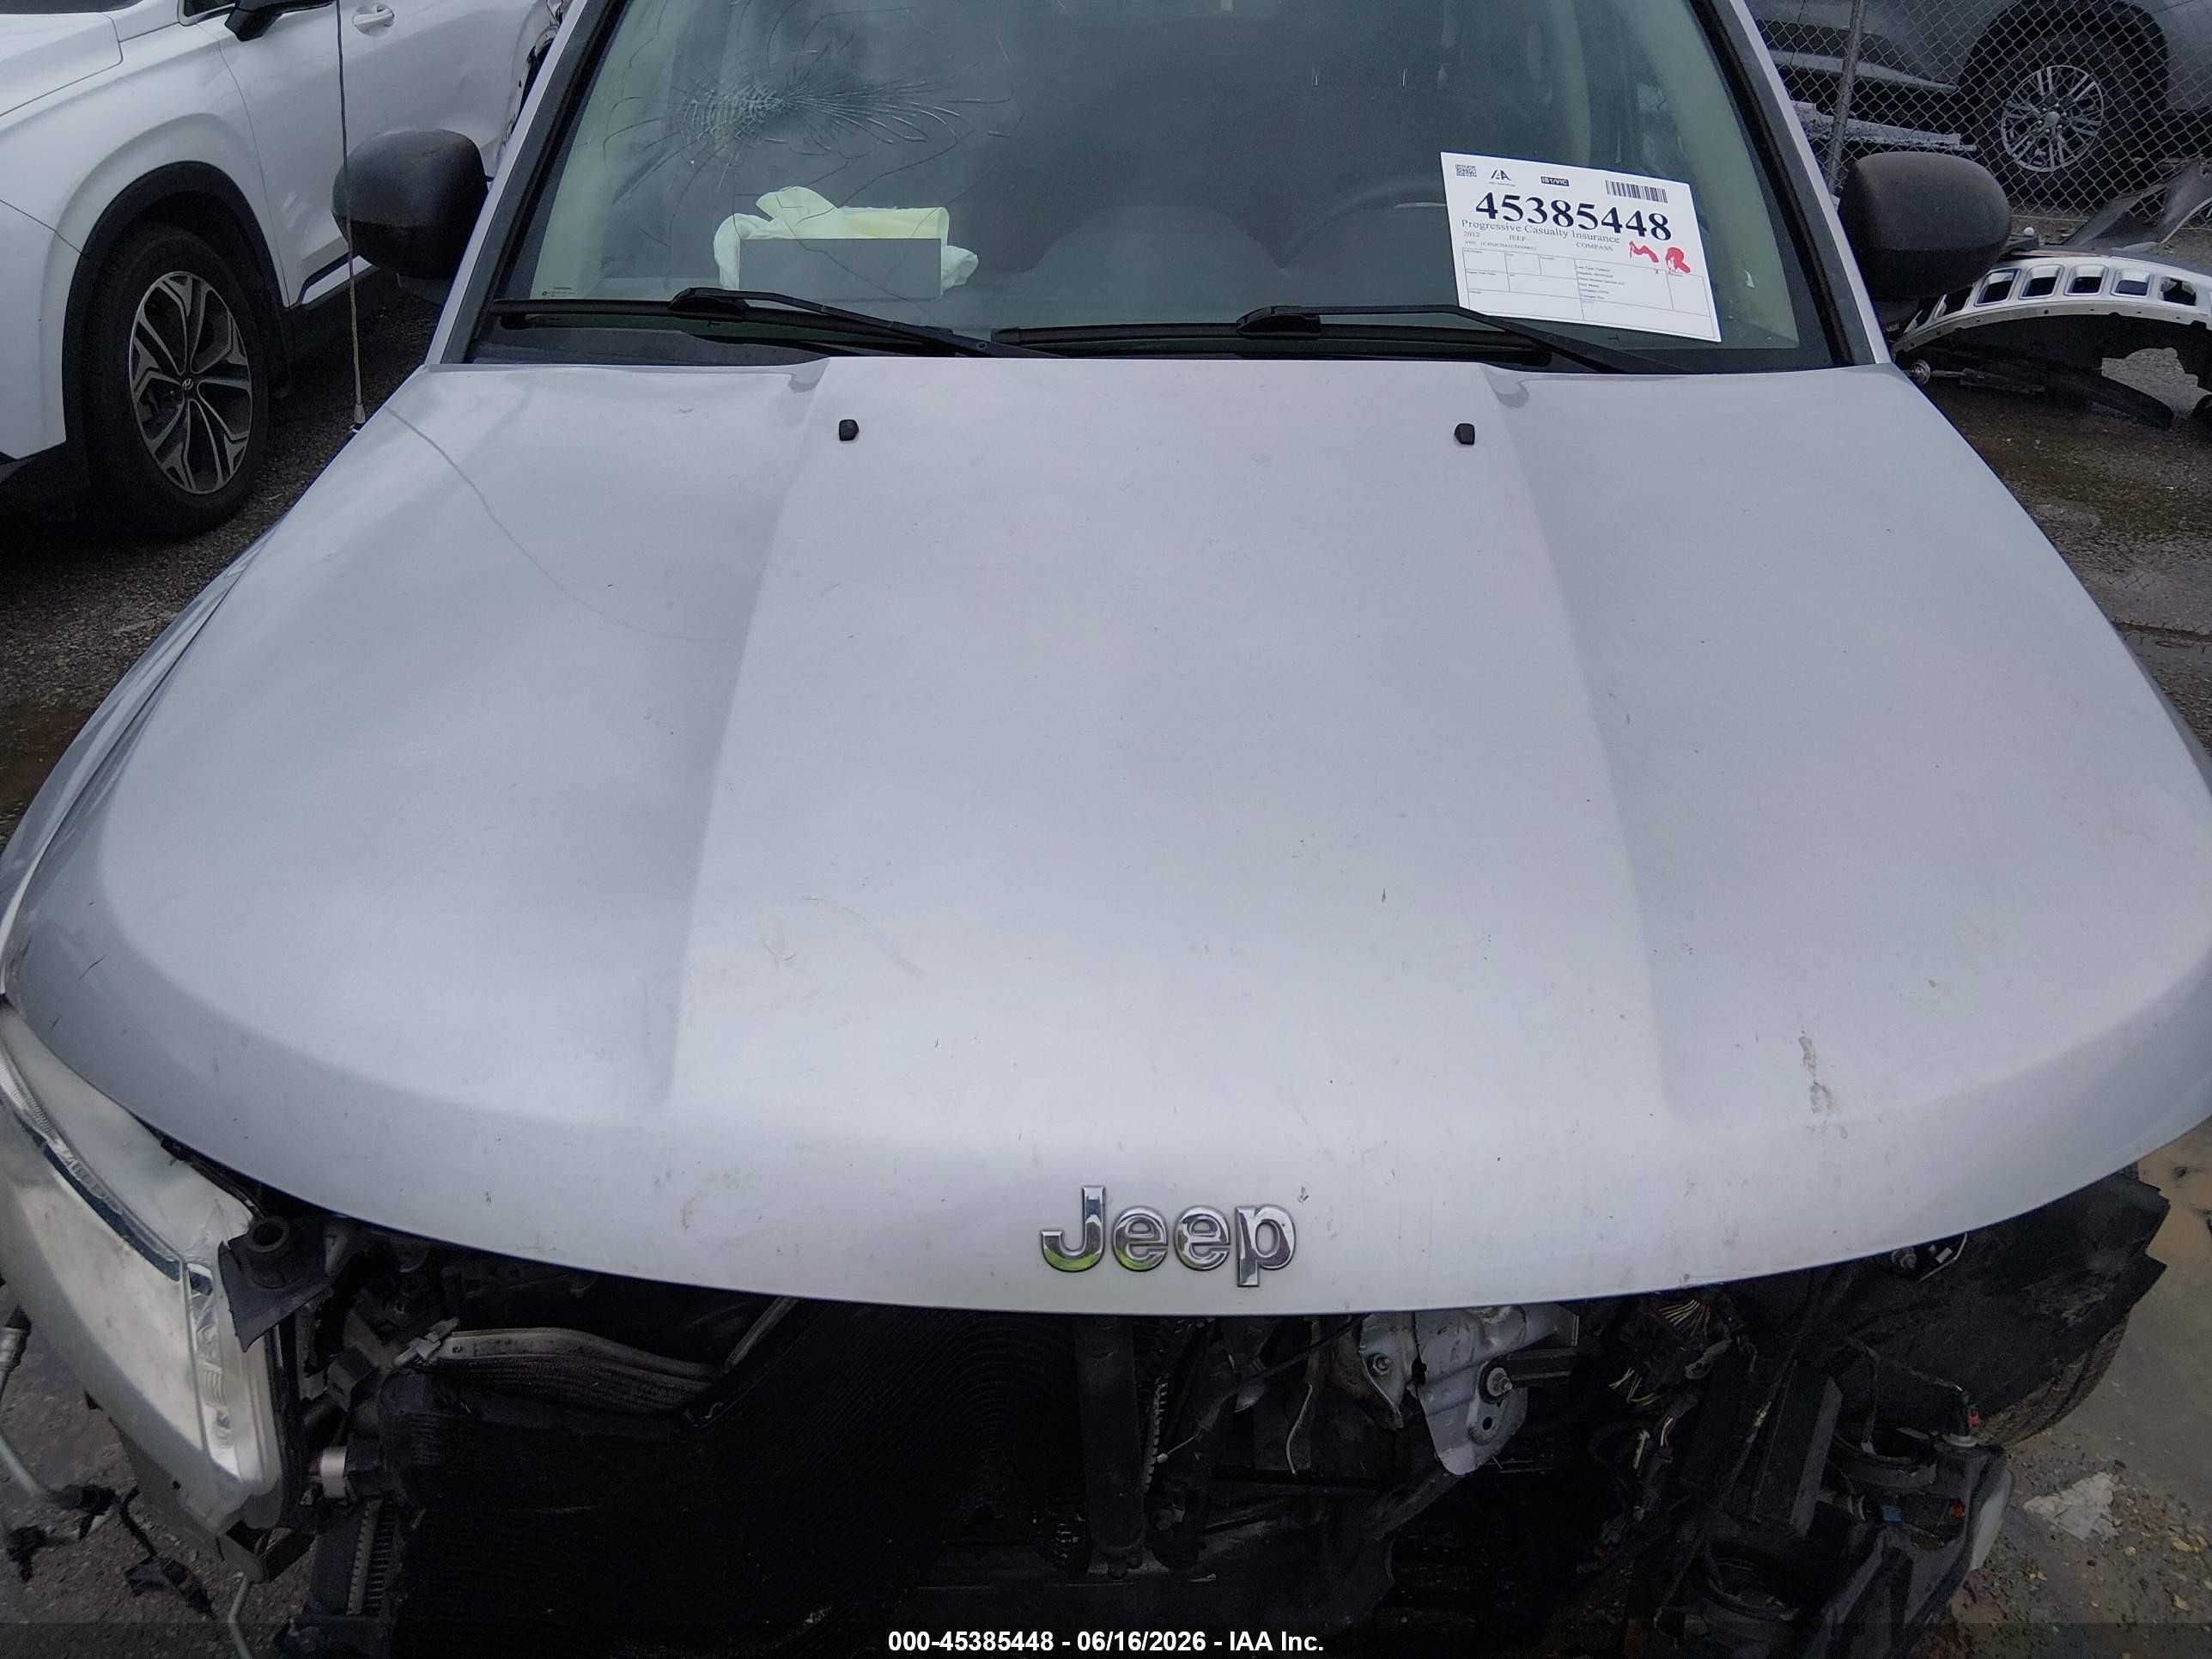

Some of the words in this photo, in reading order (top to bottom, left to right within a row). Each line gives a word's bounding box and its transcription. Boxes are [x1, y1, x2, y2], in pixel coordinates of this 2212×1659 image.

[1462, 219, 1522, 232] Progressive
[1524, 226, 1569, 239] Casualty
[1572, 230, 1620, 243] Insurance
[1475, 191, 1672, 240] 45385448
[1576, 242, 1613, 252] COMPASS
[1041, 1185, 1296, 1287] Jeep
